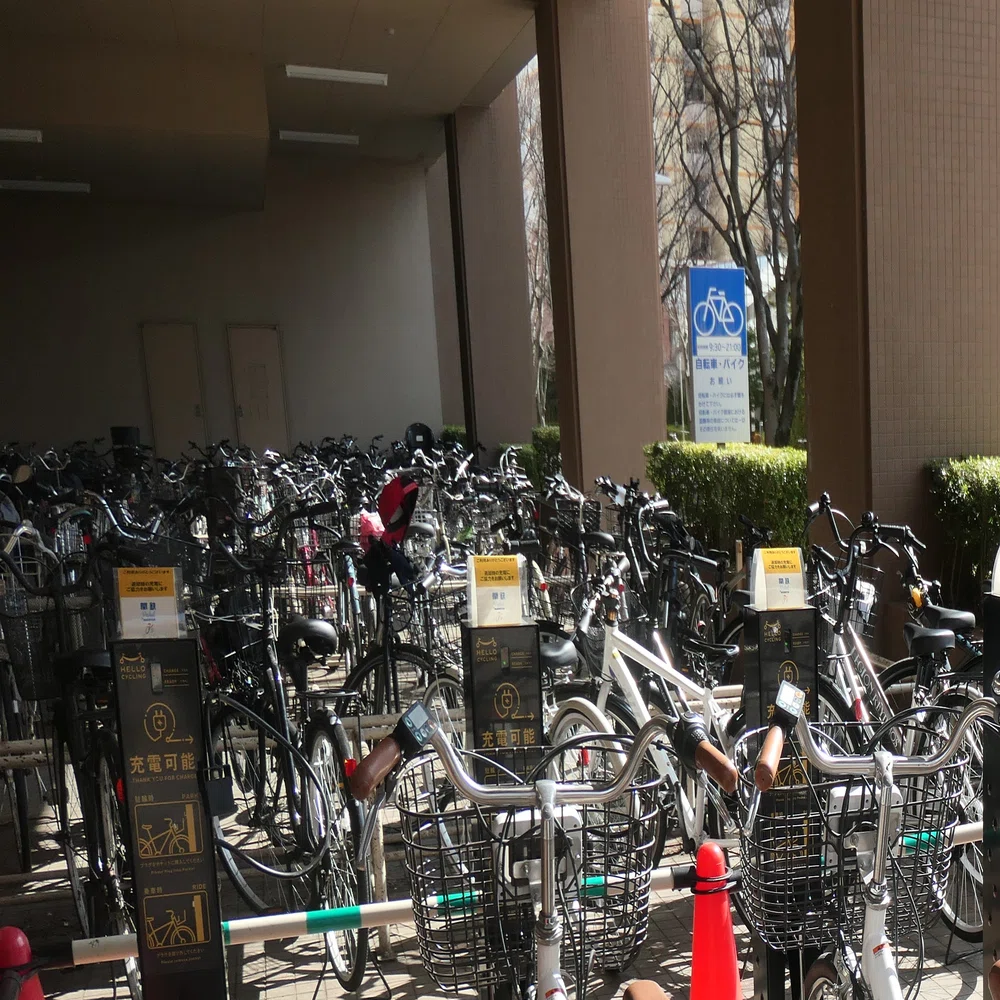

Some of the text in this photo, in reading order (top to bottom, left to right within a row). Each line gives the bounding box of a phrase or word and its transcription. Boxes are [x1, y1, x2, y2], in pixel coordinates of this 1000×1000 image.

[696, 358, 745, 370] 自転車・バイク
[120, 665, 146, 673] HELLO
[766, 701, 810, 719] 充能
[482, 728, 536, 748] 充電可能
[129, 752, 196, 774] 充電可能
